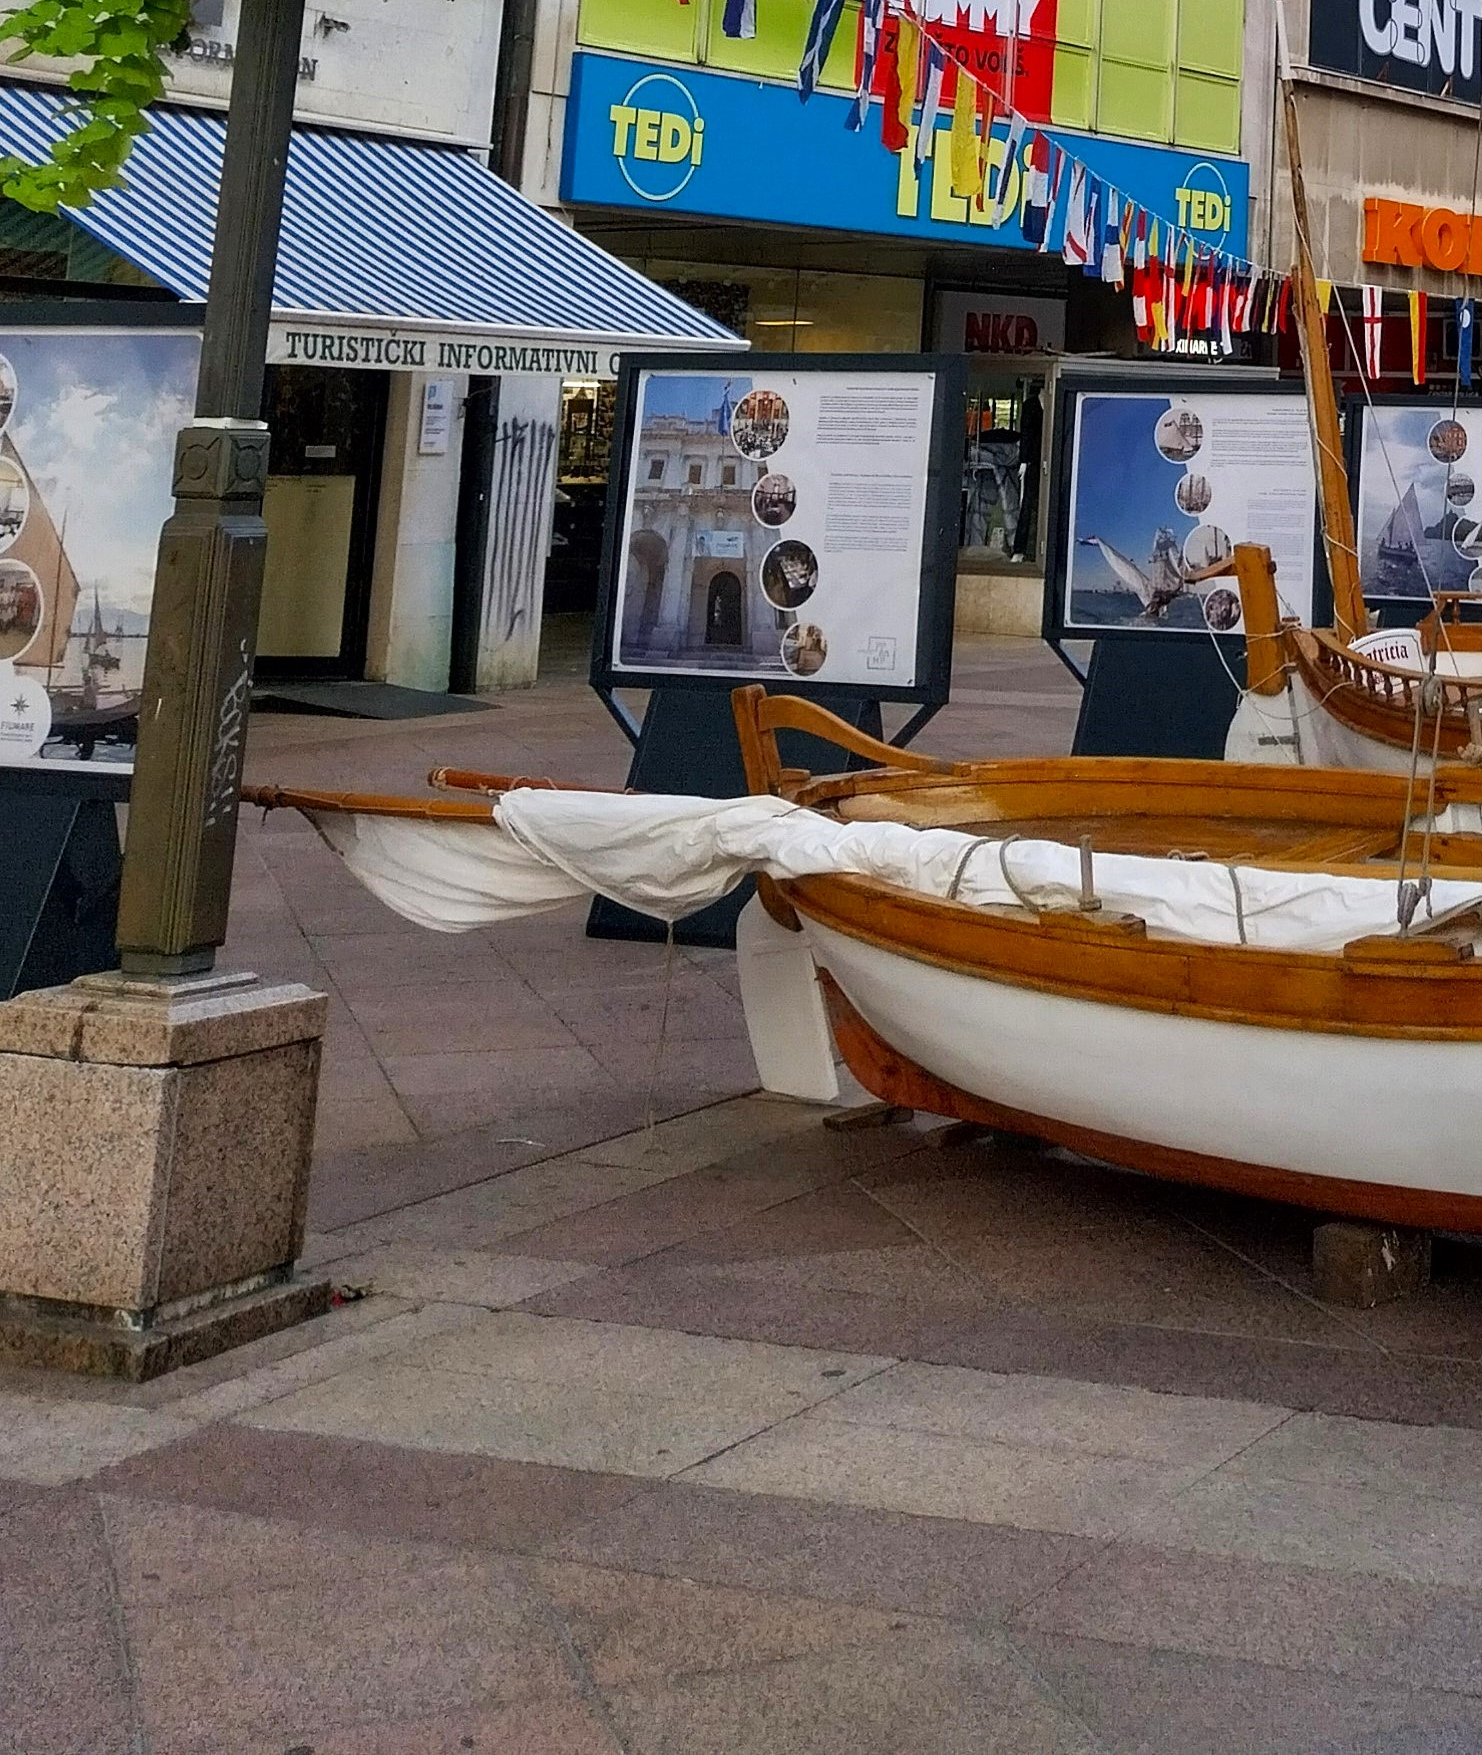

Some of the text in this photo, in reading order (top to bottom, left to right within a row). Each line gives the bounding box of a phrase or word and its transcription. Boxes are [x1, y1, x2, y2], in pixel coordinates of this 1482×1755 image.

[609, 103, 706, 167] TEDi
[1175, 187, 1233, 237] TEDi
[285, 329, 427, 366] TURISTIČKI
[437, 341, 599, 375] INFORMATIVNI
[965, 310, 1040, 356] NKD
